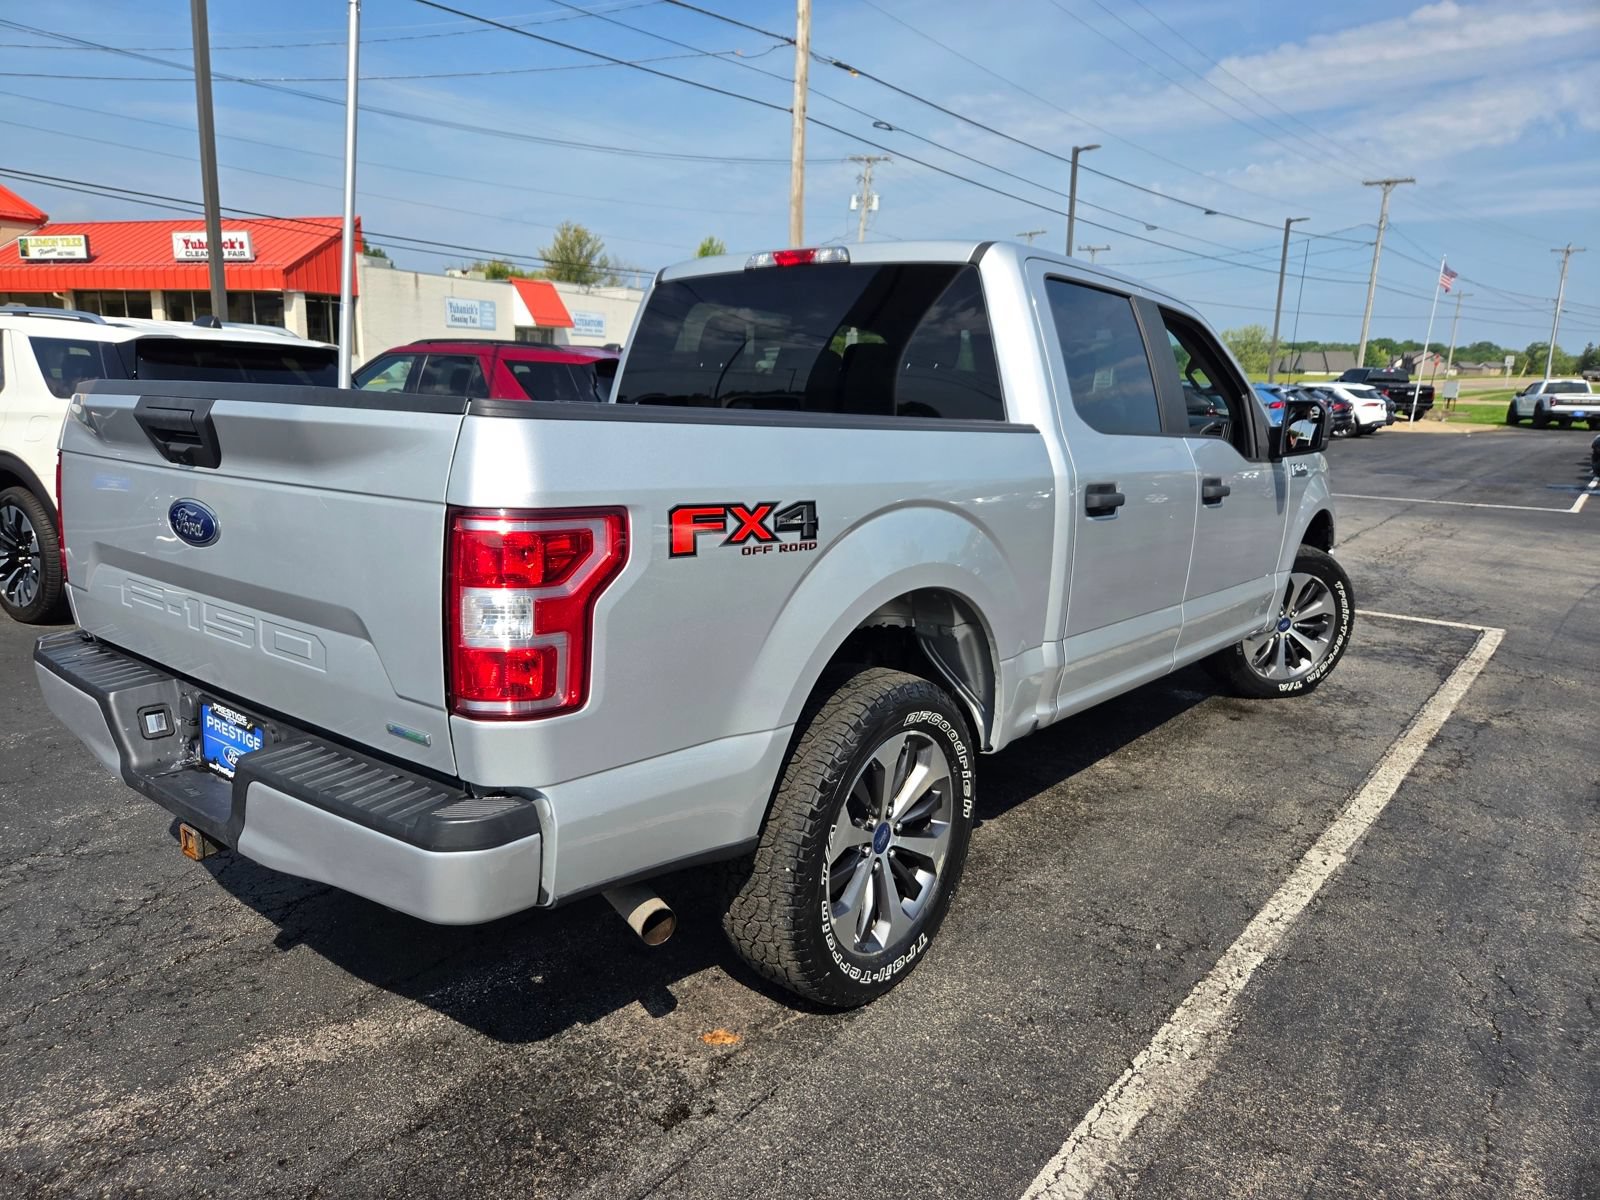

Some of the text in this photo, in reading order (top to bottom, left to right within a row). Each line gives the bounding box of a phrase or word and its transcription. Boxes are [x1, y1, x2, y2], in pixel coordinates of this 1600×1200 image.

[29, 237, 82, 247] LEMON TREE
[175, 507, 204, 537] Ford
[667, 499, 819, 559] FX4
[741, 541, 818, 556] OFF ROAD
[120, 577, 328, 673] F-150
[206, 715, 261, 750] PRESTIGE
[903, 710, 972, 819] BFGoodrich
[820, 823, 837, 885] T/A
